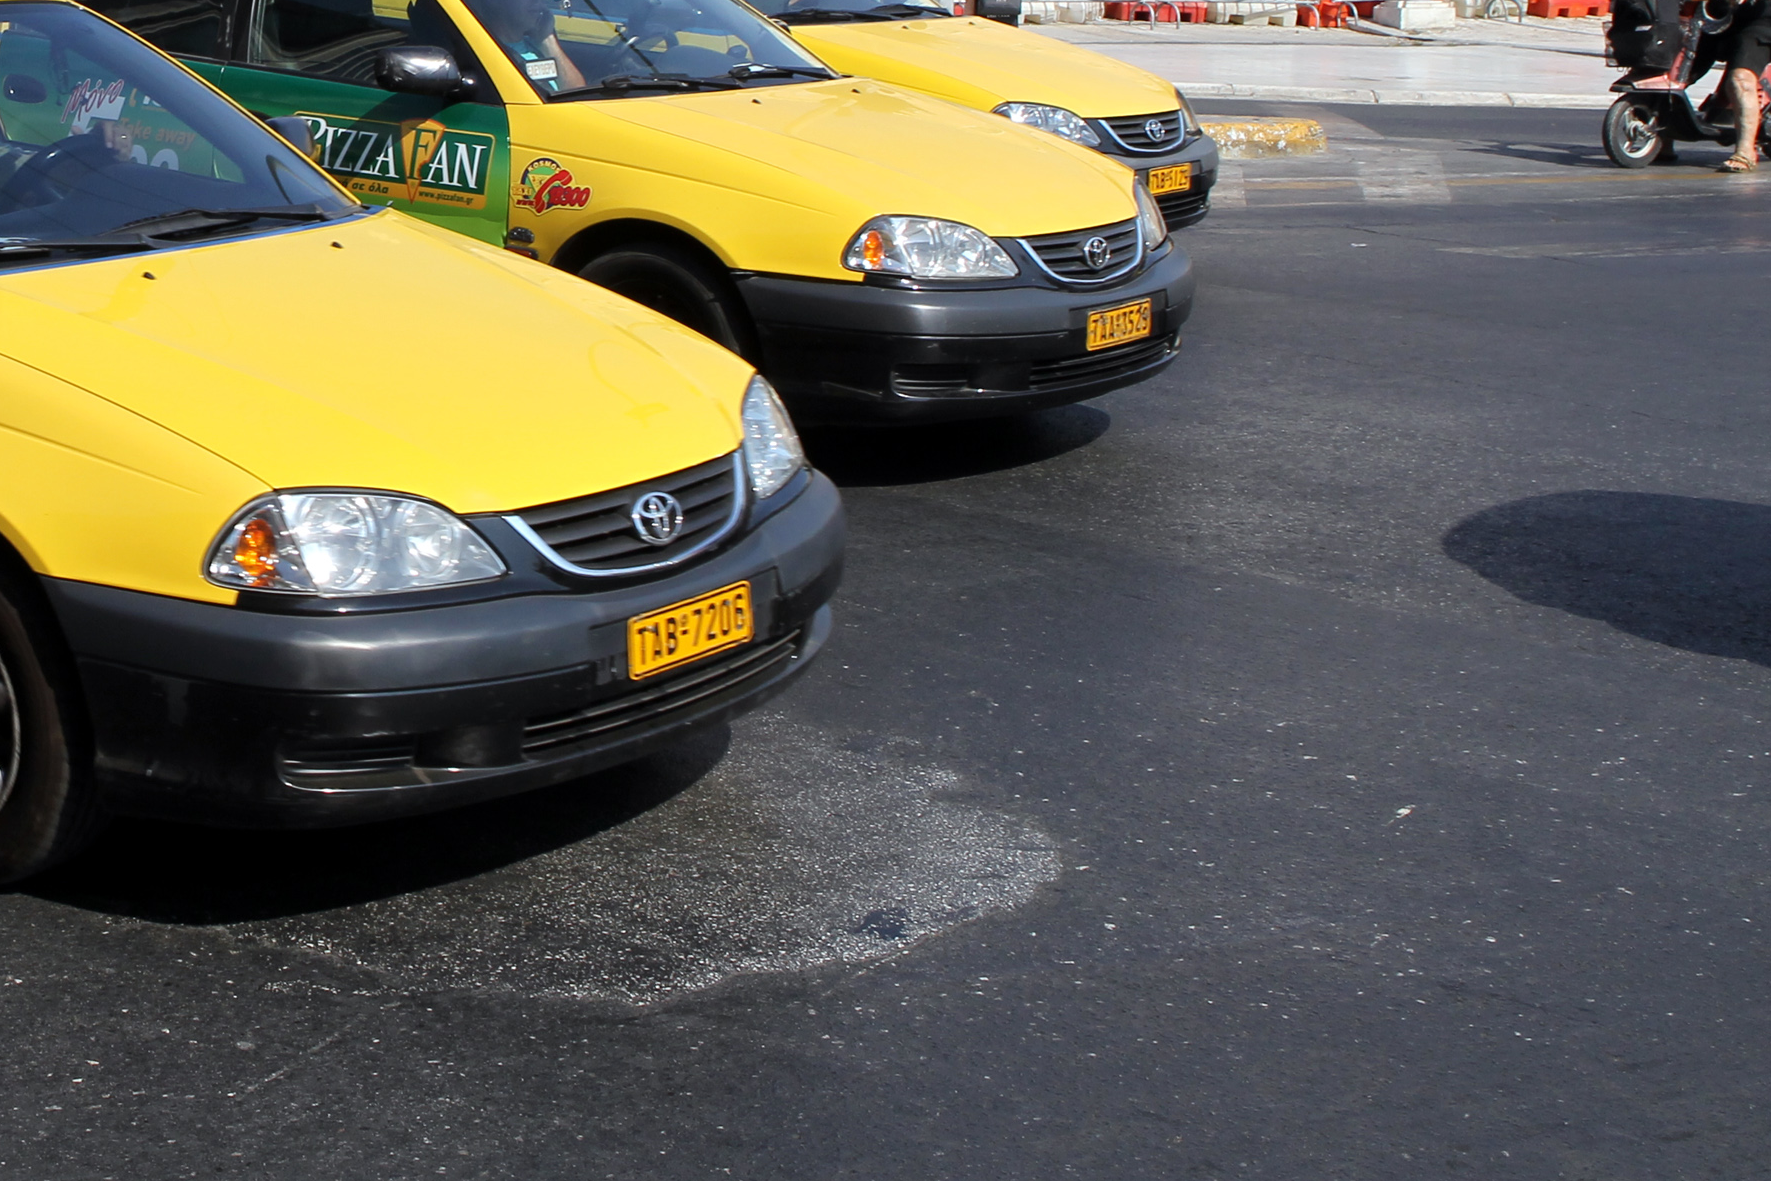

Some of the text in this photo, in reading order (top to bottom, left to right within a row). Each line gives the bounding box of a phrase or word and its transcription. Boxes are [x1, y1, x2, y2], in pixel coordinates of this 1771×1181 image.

[155, 128, 196, 152] away
[352, 181, 365, 190] σε
[368, 182, 389, 194] όλα
[636, 593, 744, 666] TAB-7206
